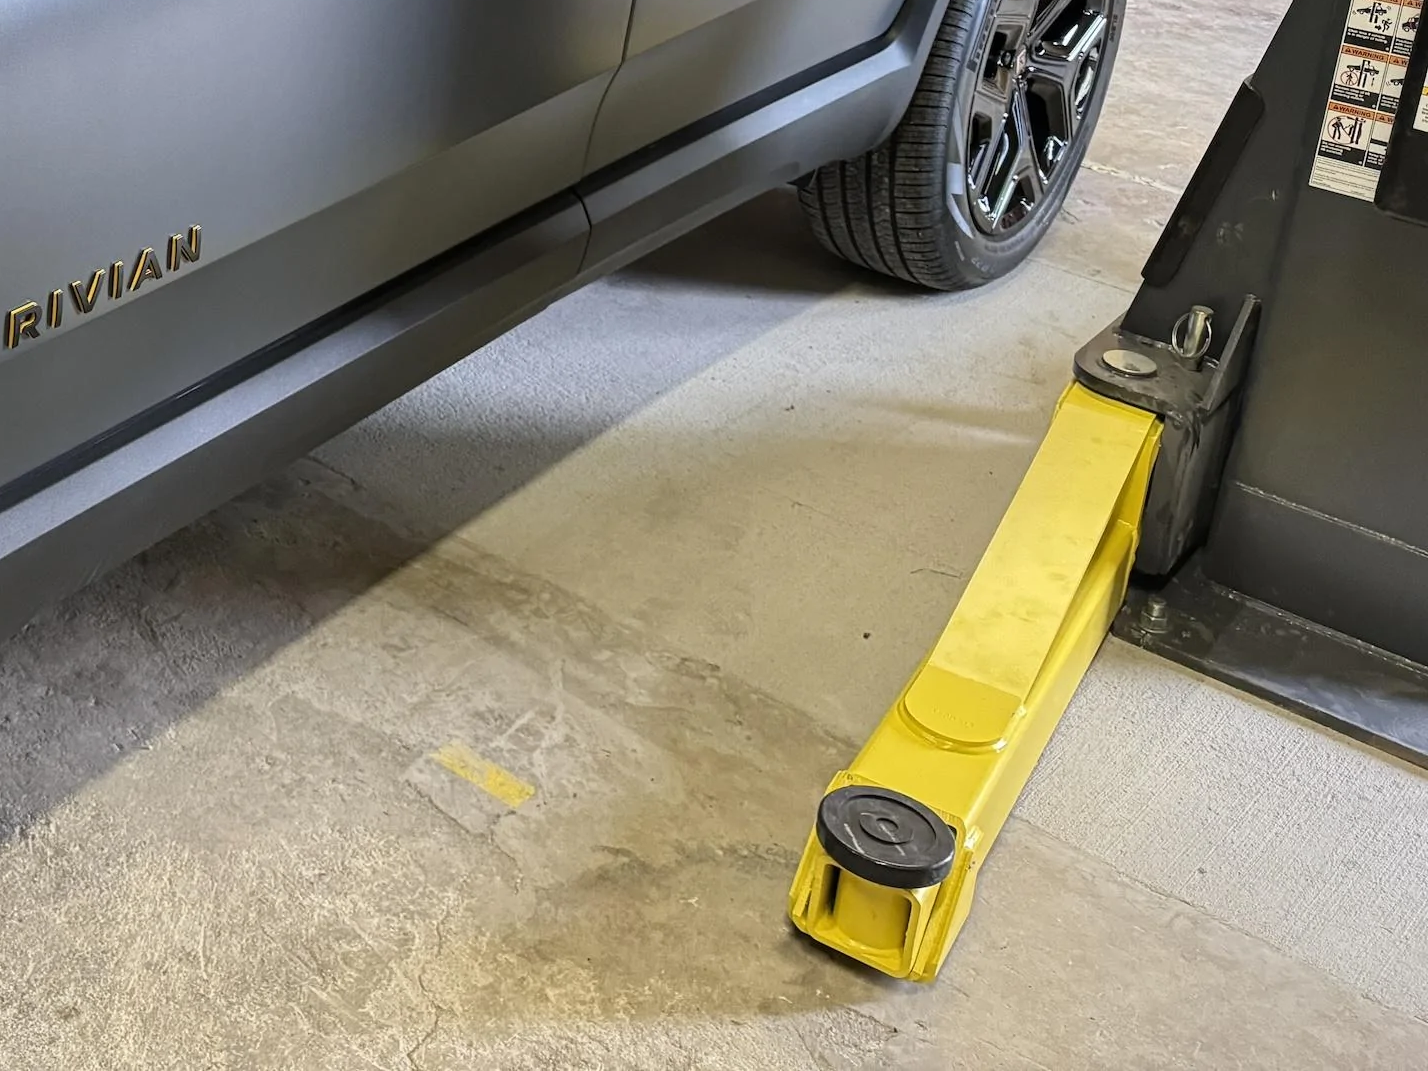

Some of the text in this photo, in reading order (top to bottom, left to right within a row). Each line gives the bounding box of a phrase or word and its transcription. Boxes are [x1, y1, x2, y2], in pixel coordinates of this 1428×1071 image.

[1352, 49, 1384, 60] WARNING
[1339, 106, 1371, 118] WARNING
[4, 225, 202, 349] RIVIAN
